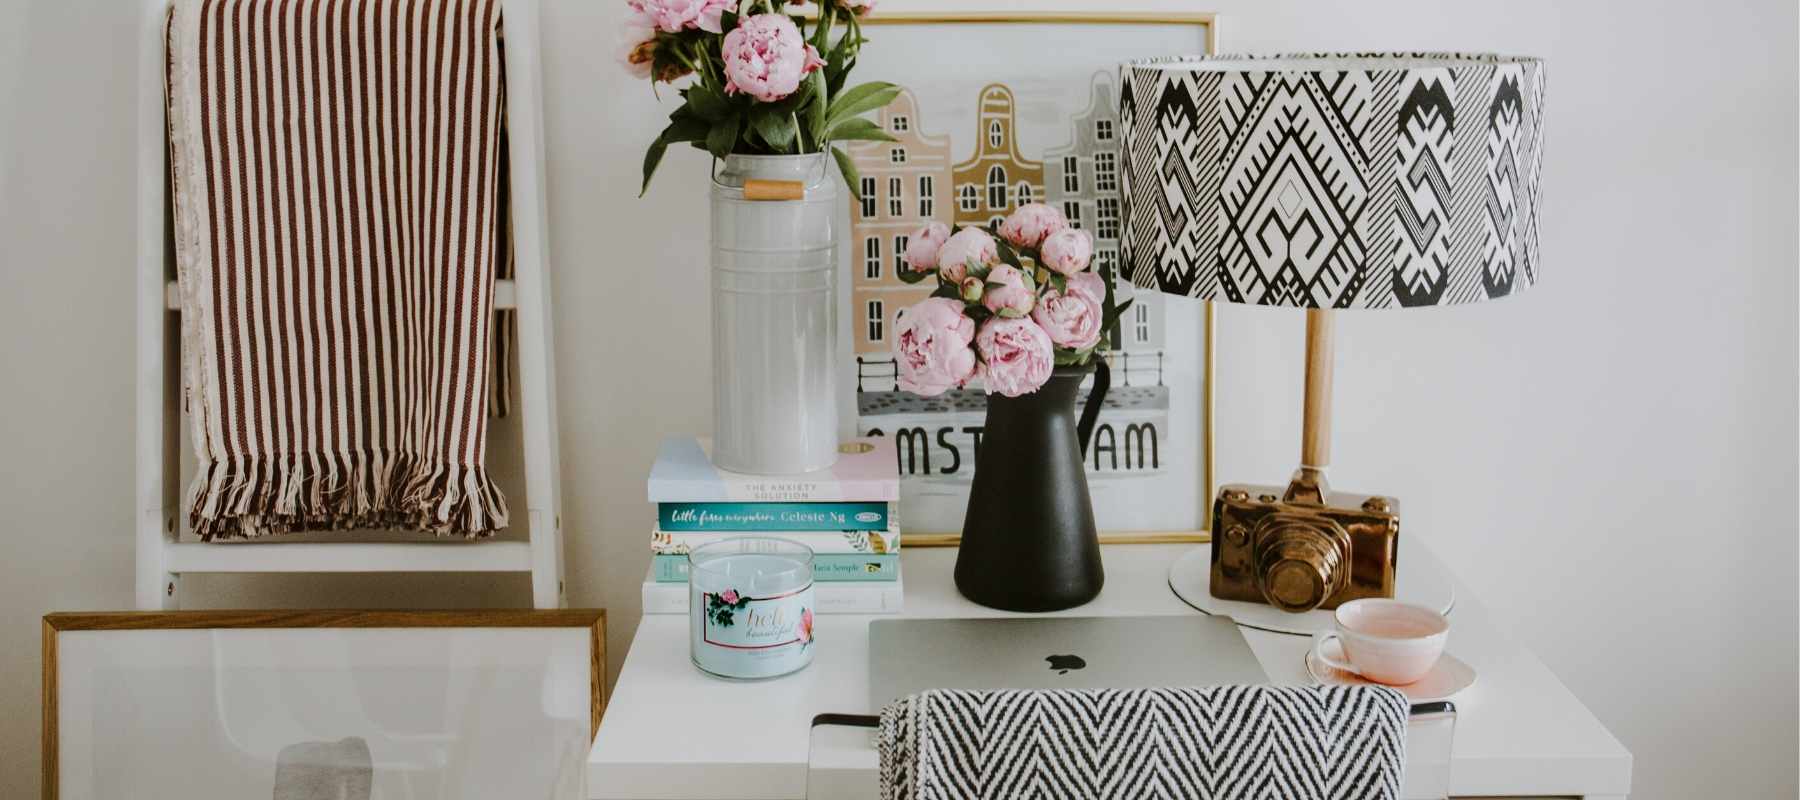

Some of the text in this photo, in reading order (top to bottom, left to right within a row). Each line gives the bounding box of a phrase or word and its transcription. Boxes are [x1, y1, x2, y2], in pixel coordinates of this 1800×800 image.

[866, 423, 1158, 475] MSTAM
[672, 510, 698, 522] Little
[780, 511, 846, 524] Celeste Ng
